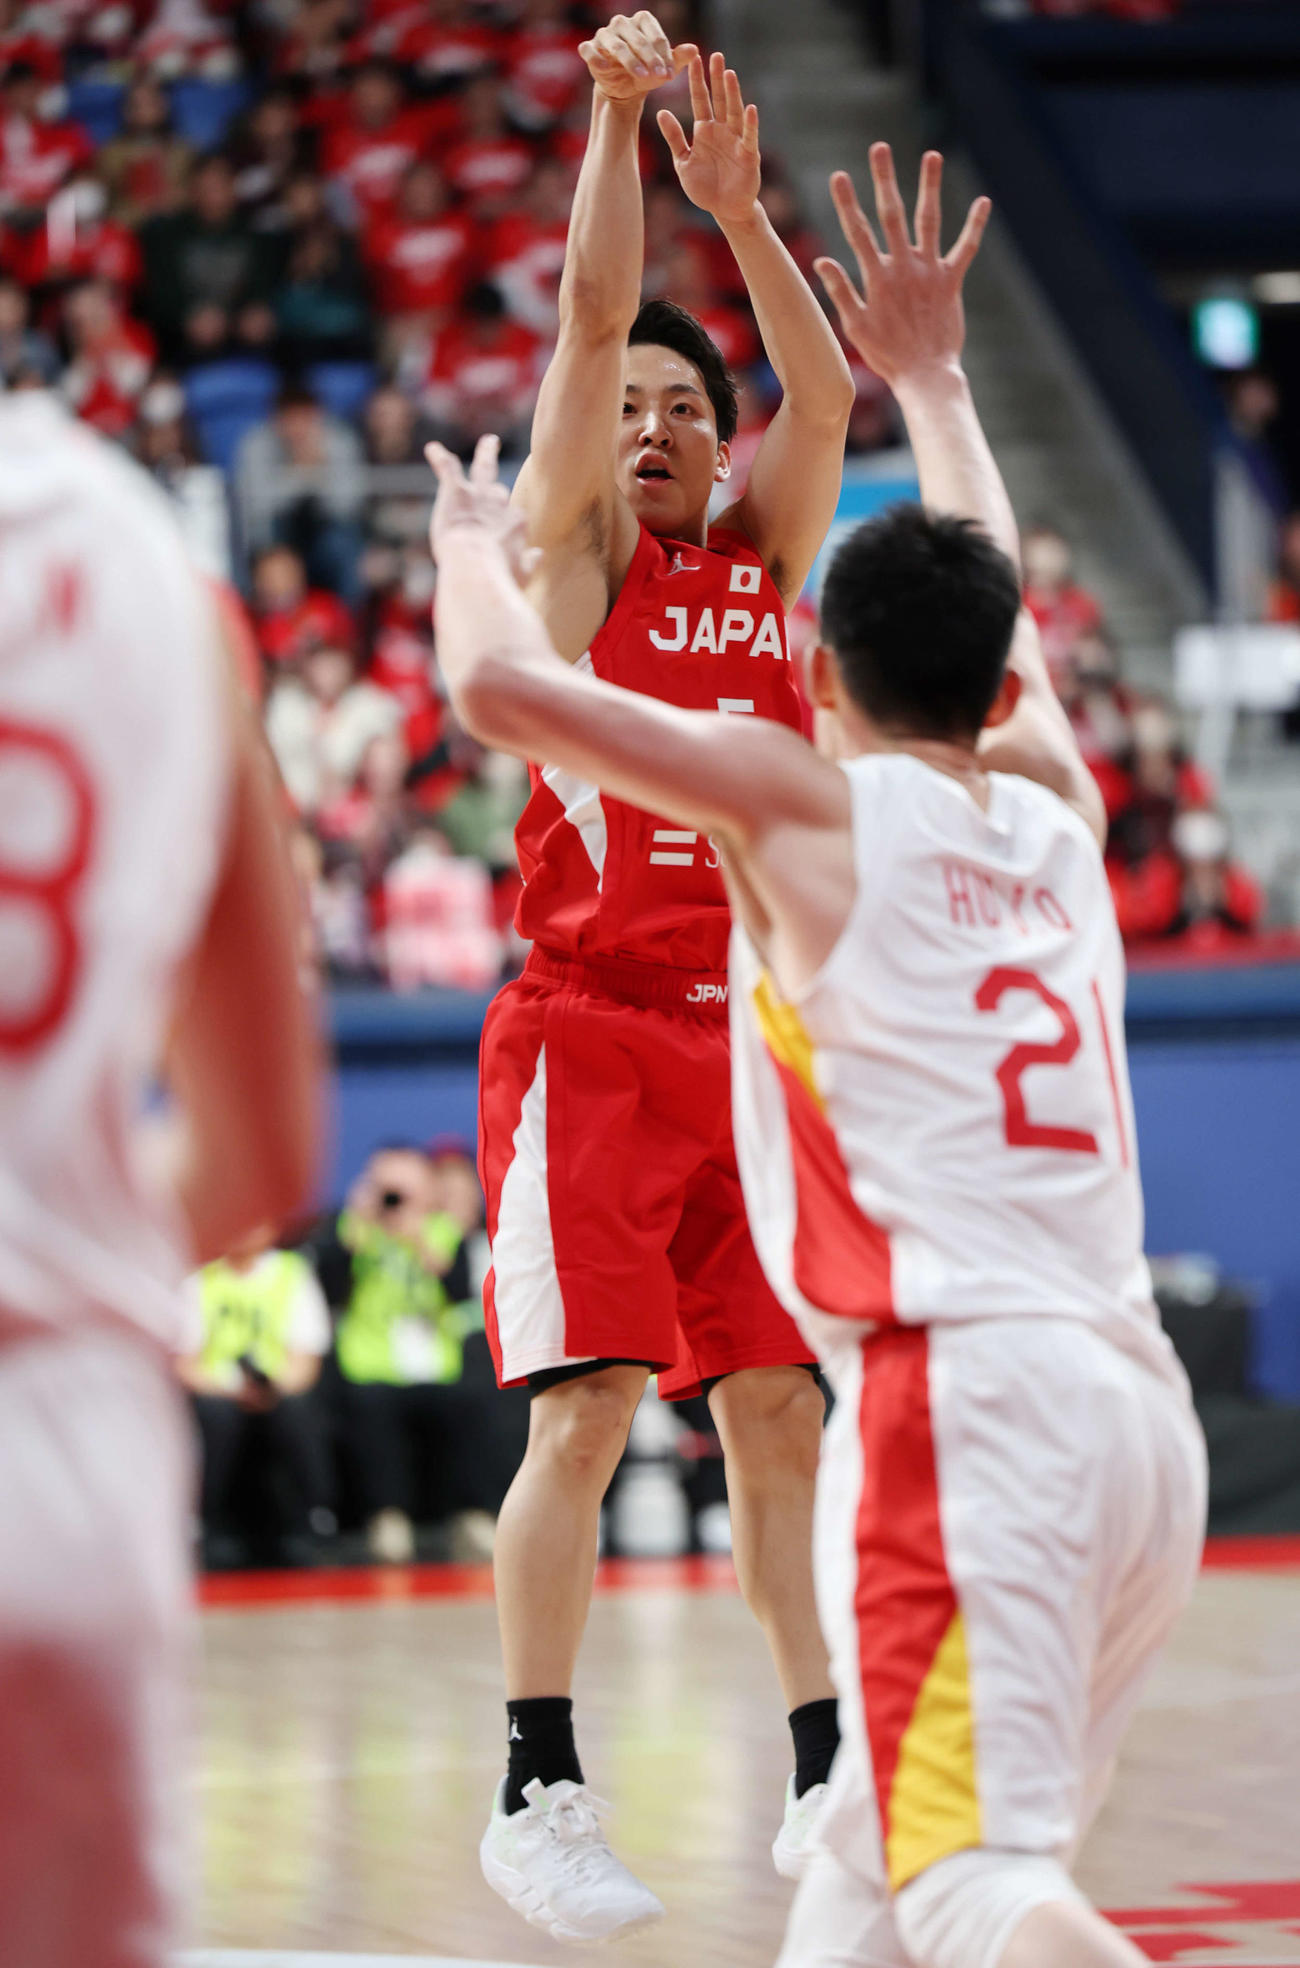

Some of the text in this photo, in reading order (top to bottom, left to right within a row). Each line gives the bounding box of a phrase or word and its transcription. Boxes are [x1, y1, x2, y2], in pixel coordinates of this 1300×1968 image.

[648, 605, 792, 662] JAPA
[686, 984, 729, 1003] JPN
[974, 965, 1130, 1170] 21
